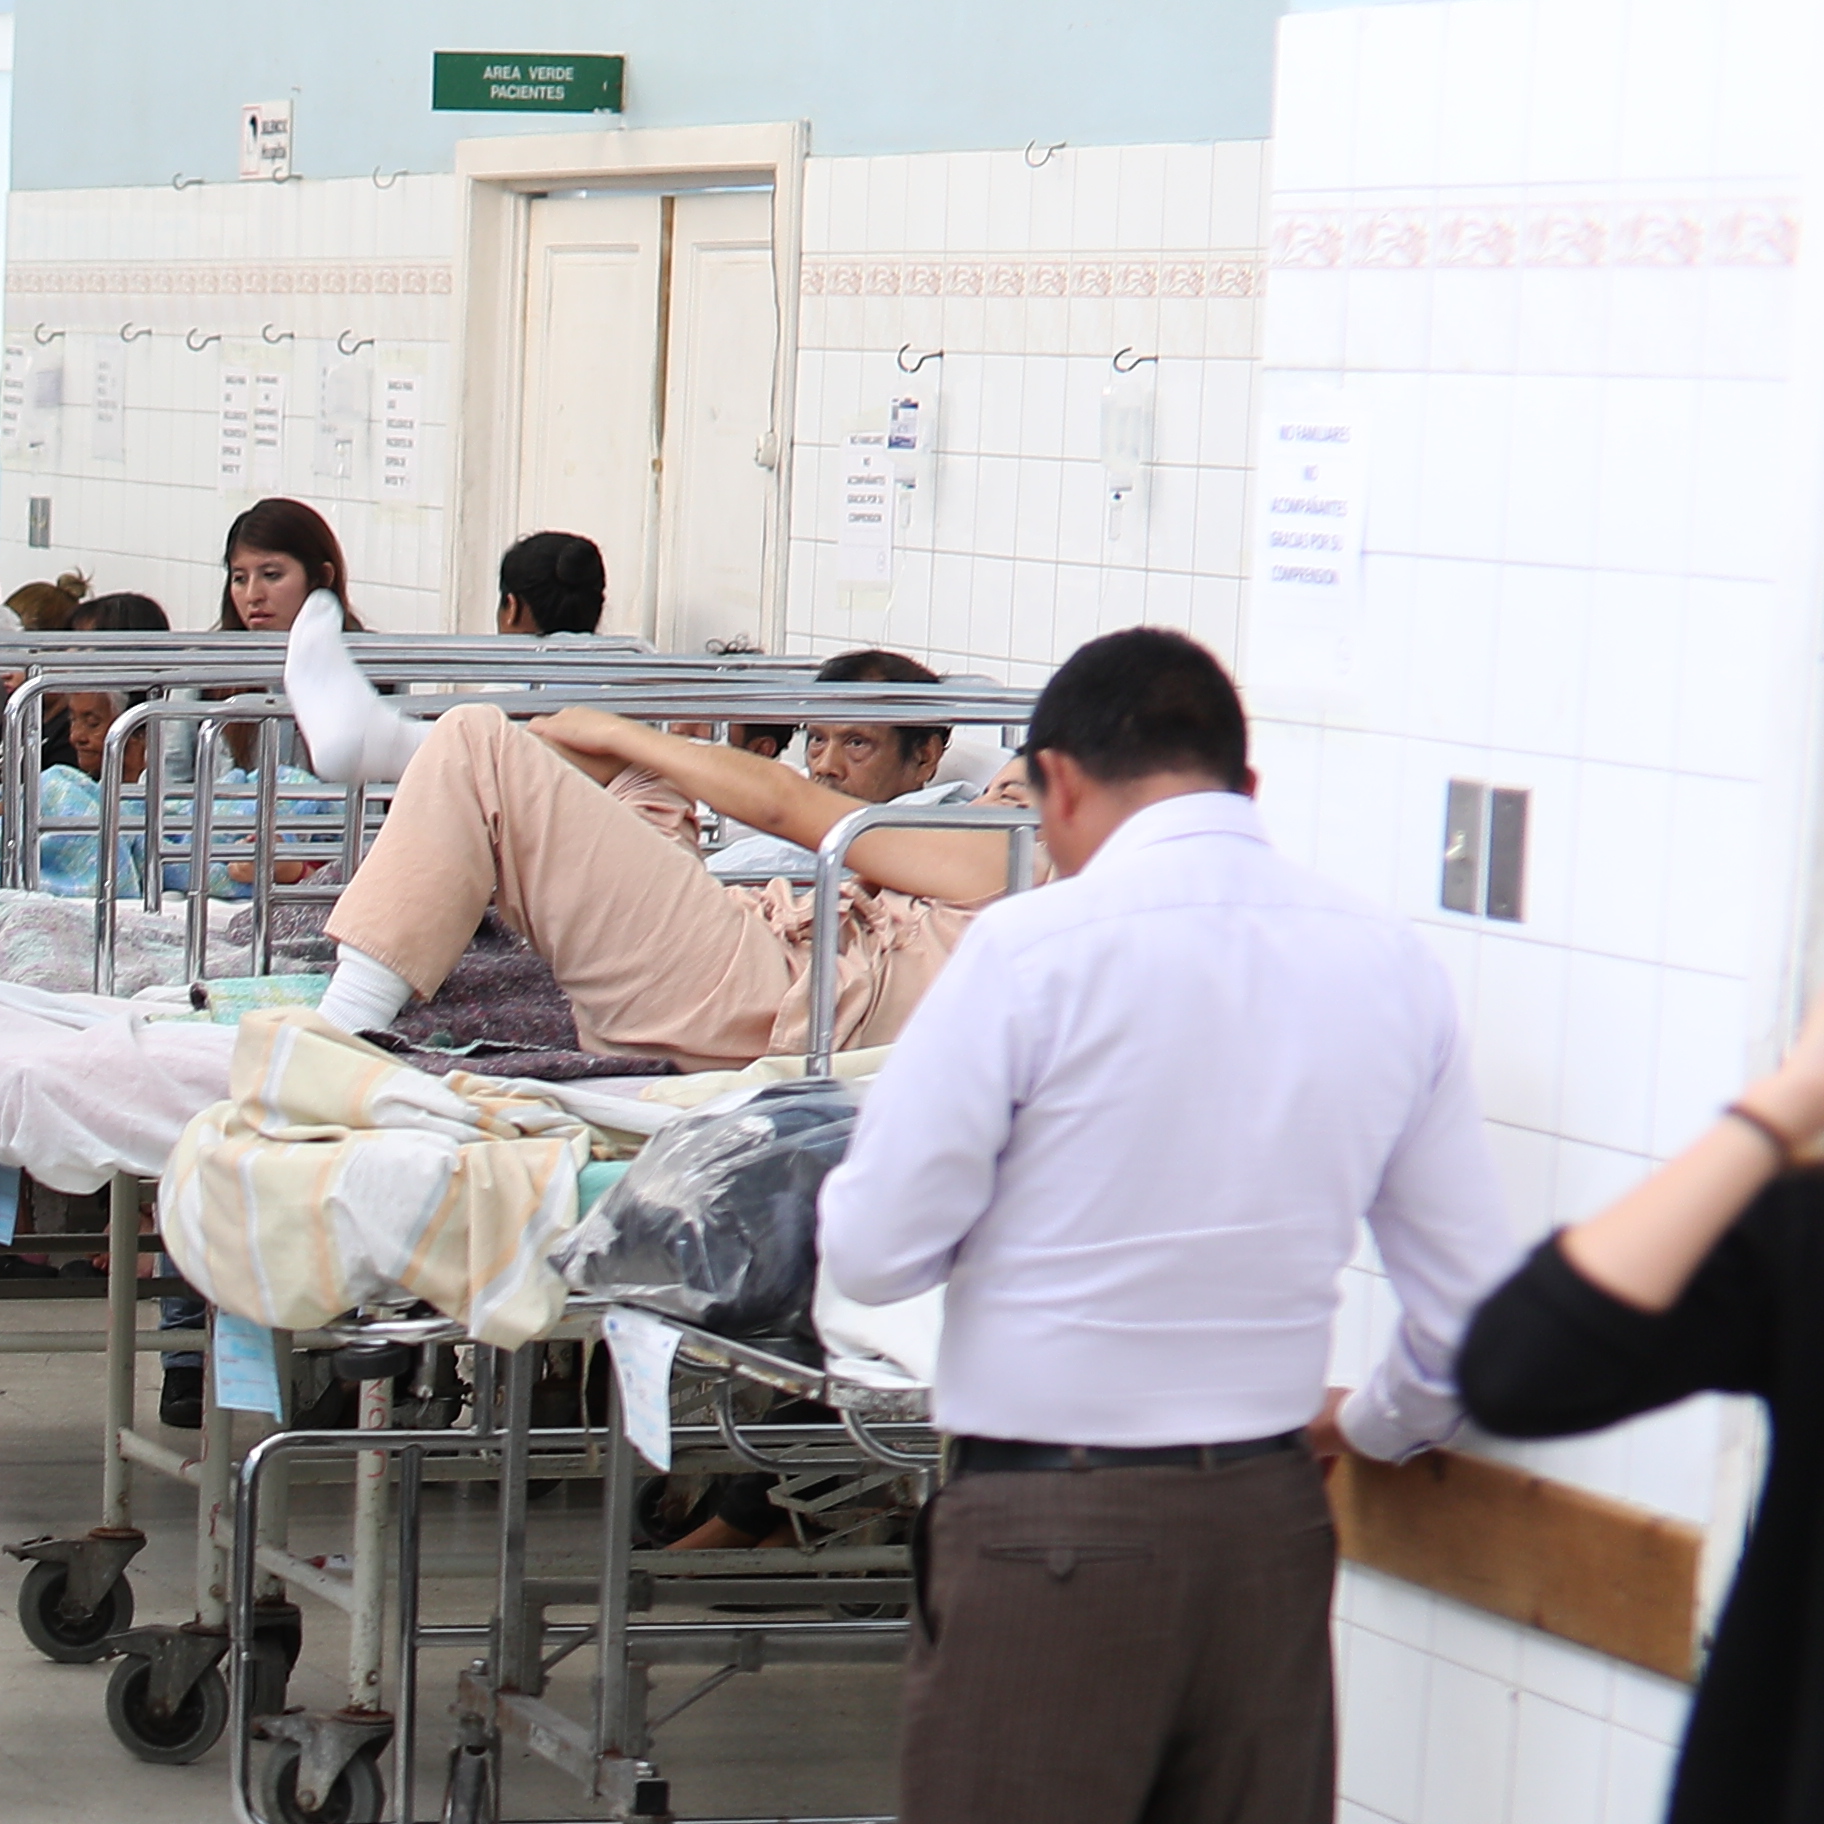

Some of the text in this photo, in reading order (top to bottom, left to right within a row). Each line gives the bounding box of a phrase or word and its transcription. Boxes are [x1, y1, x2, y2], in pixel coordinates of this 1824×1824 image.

[483, 65, 574, 81] AREA VERDE
[490, 85, 565, 100] PACIENTES
